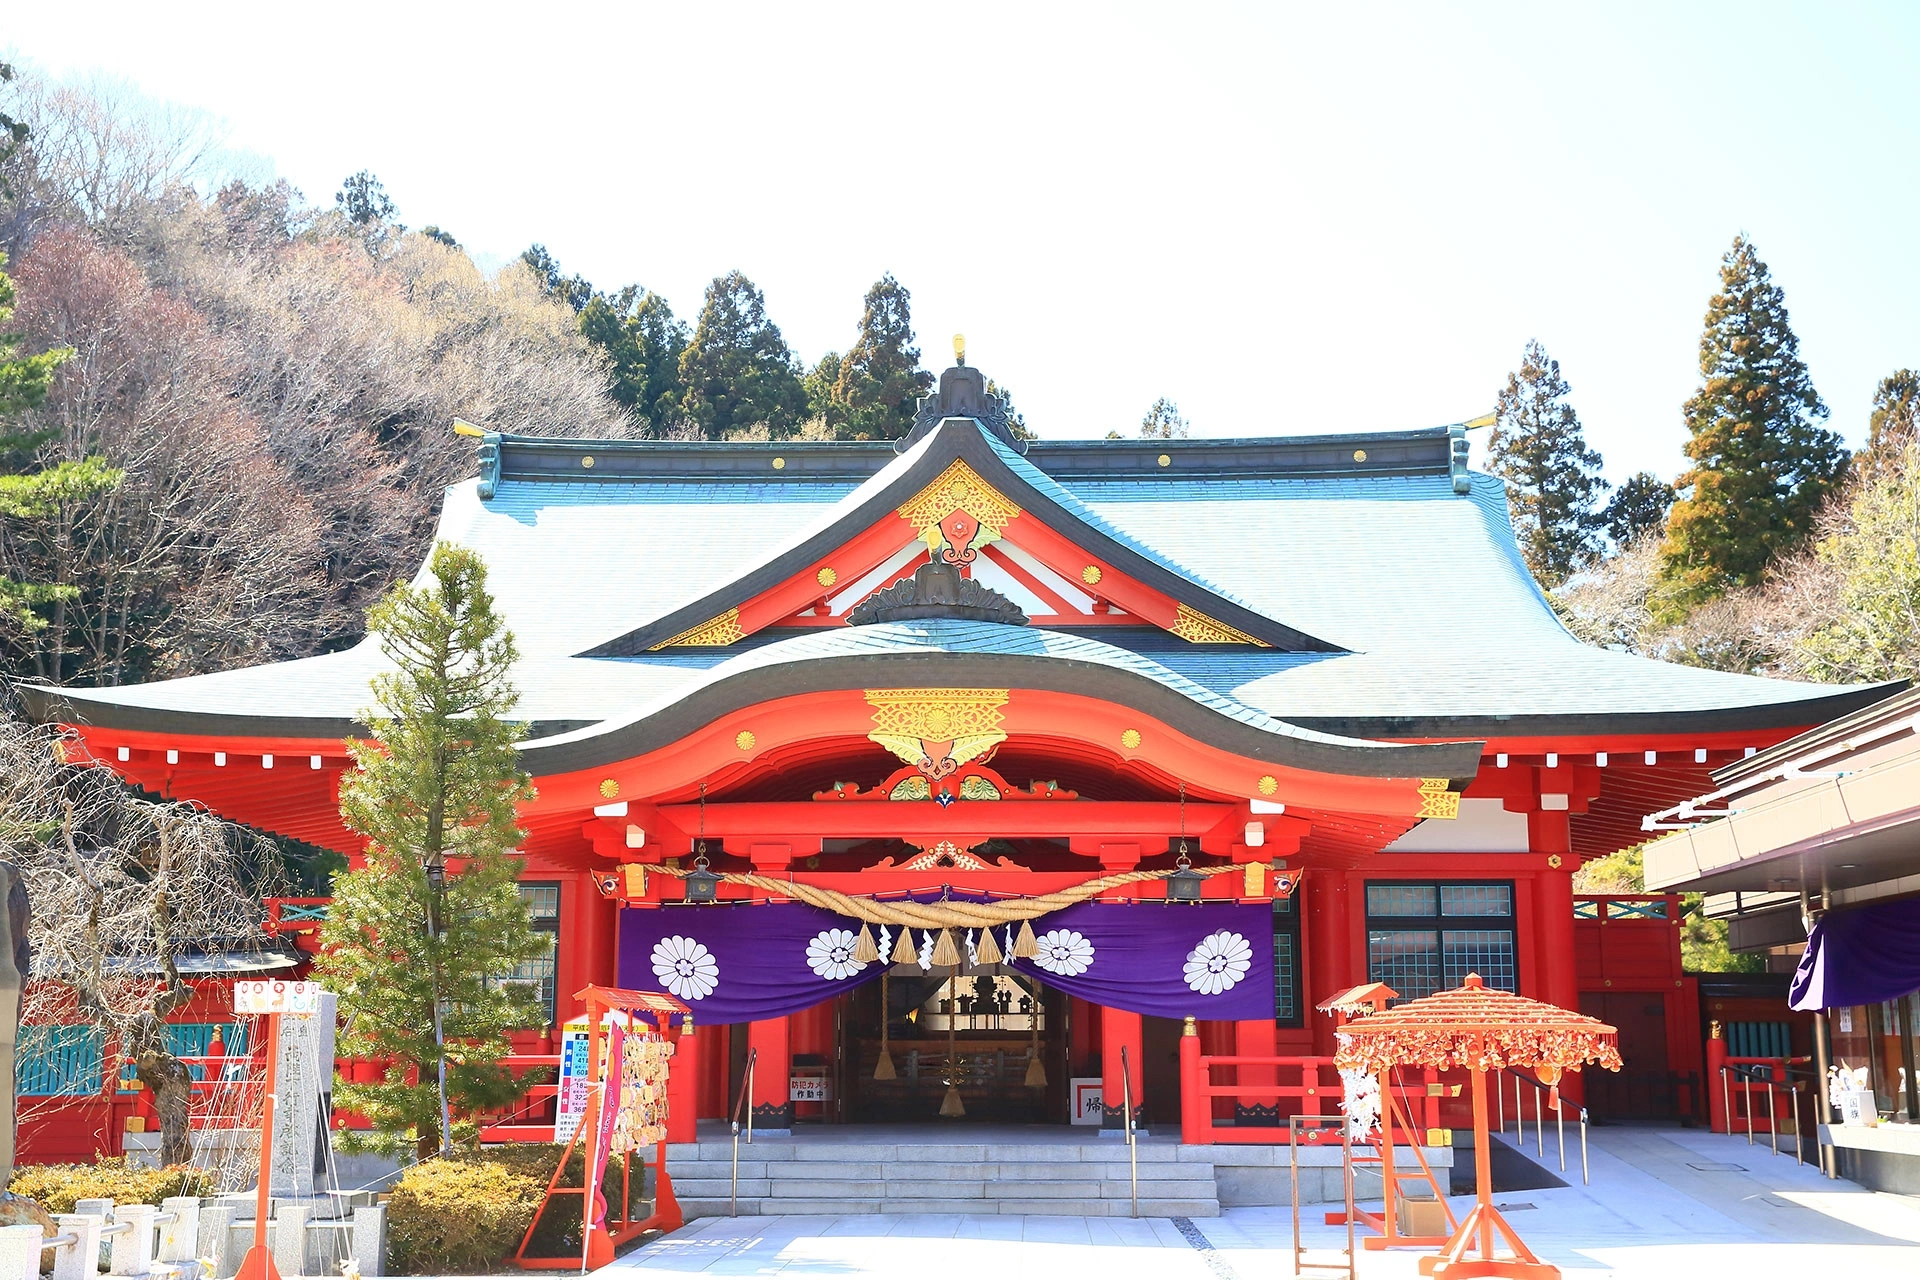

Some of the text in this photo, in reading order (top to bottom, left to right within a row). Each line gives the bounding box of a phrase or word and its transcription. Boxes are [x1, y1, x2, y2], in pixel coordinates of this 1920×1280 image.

[792, 1080, 828, 1089] 防犯カメラ
[797, 1090, 823, 1099] 作動中
[1086, 1096, 1102, 1113] 帰
[1850, 1098, 1860, 1119] 国旗
